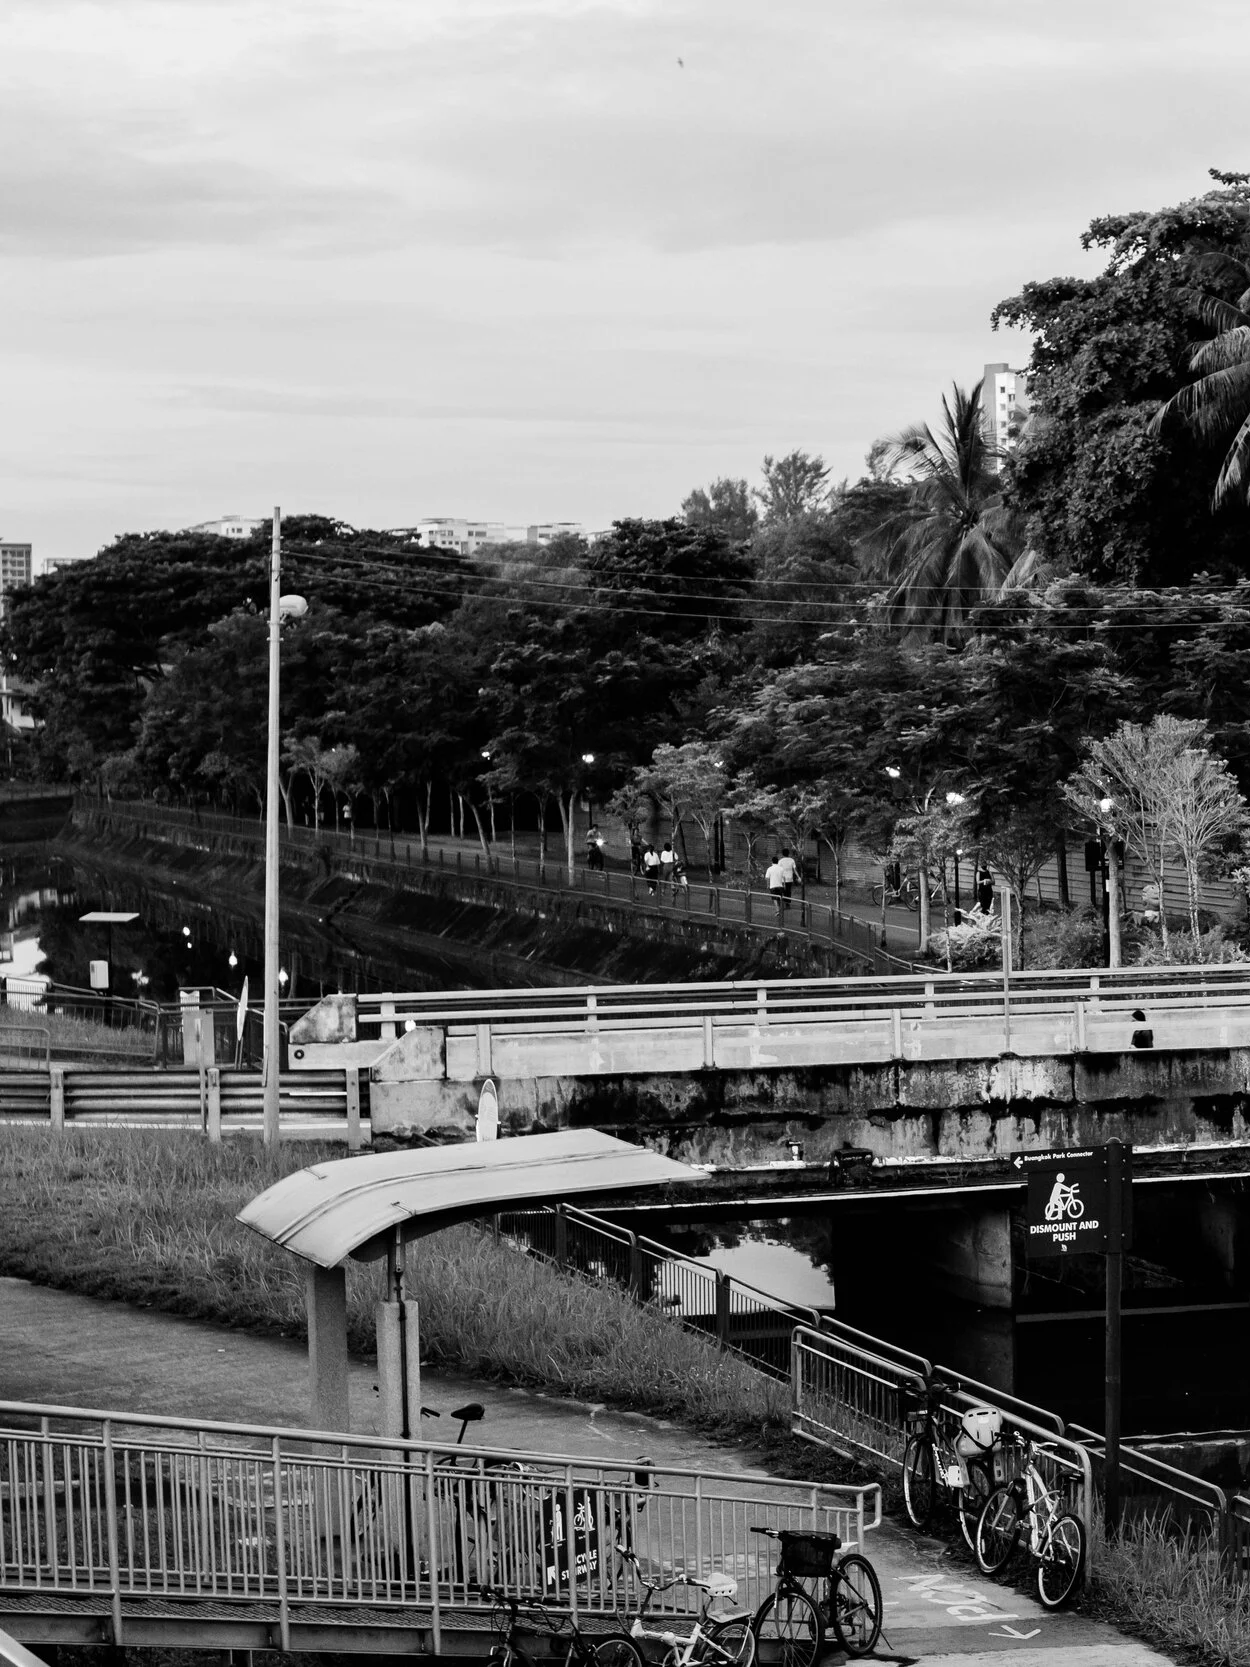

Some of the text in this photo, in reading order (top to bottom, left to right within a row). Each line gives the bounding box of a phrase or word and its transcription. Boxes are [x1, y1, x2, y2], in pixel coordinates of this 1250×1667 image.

[1024, 1153, 1052, 1162] Buangkok
[1052, 1152, 1066, 1160] Park
[1030, 1220, 1100, 1234] DISMOUNT AND
[1053, 1232, 1077, 1242] PUSH
